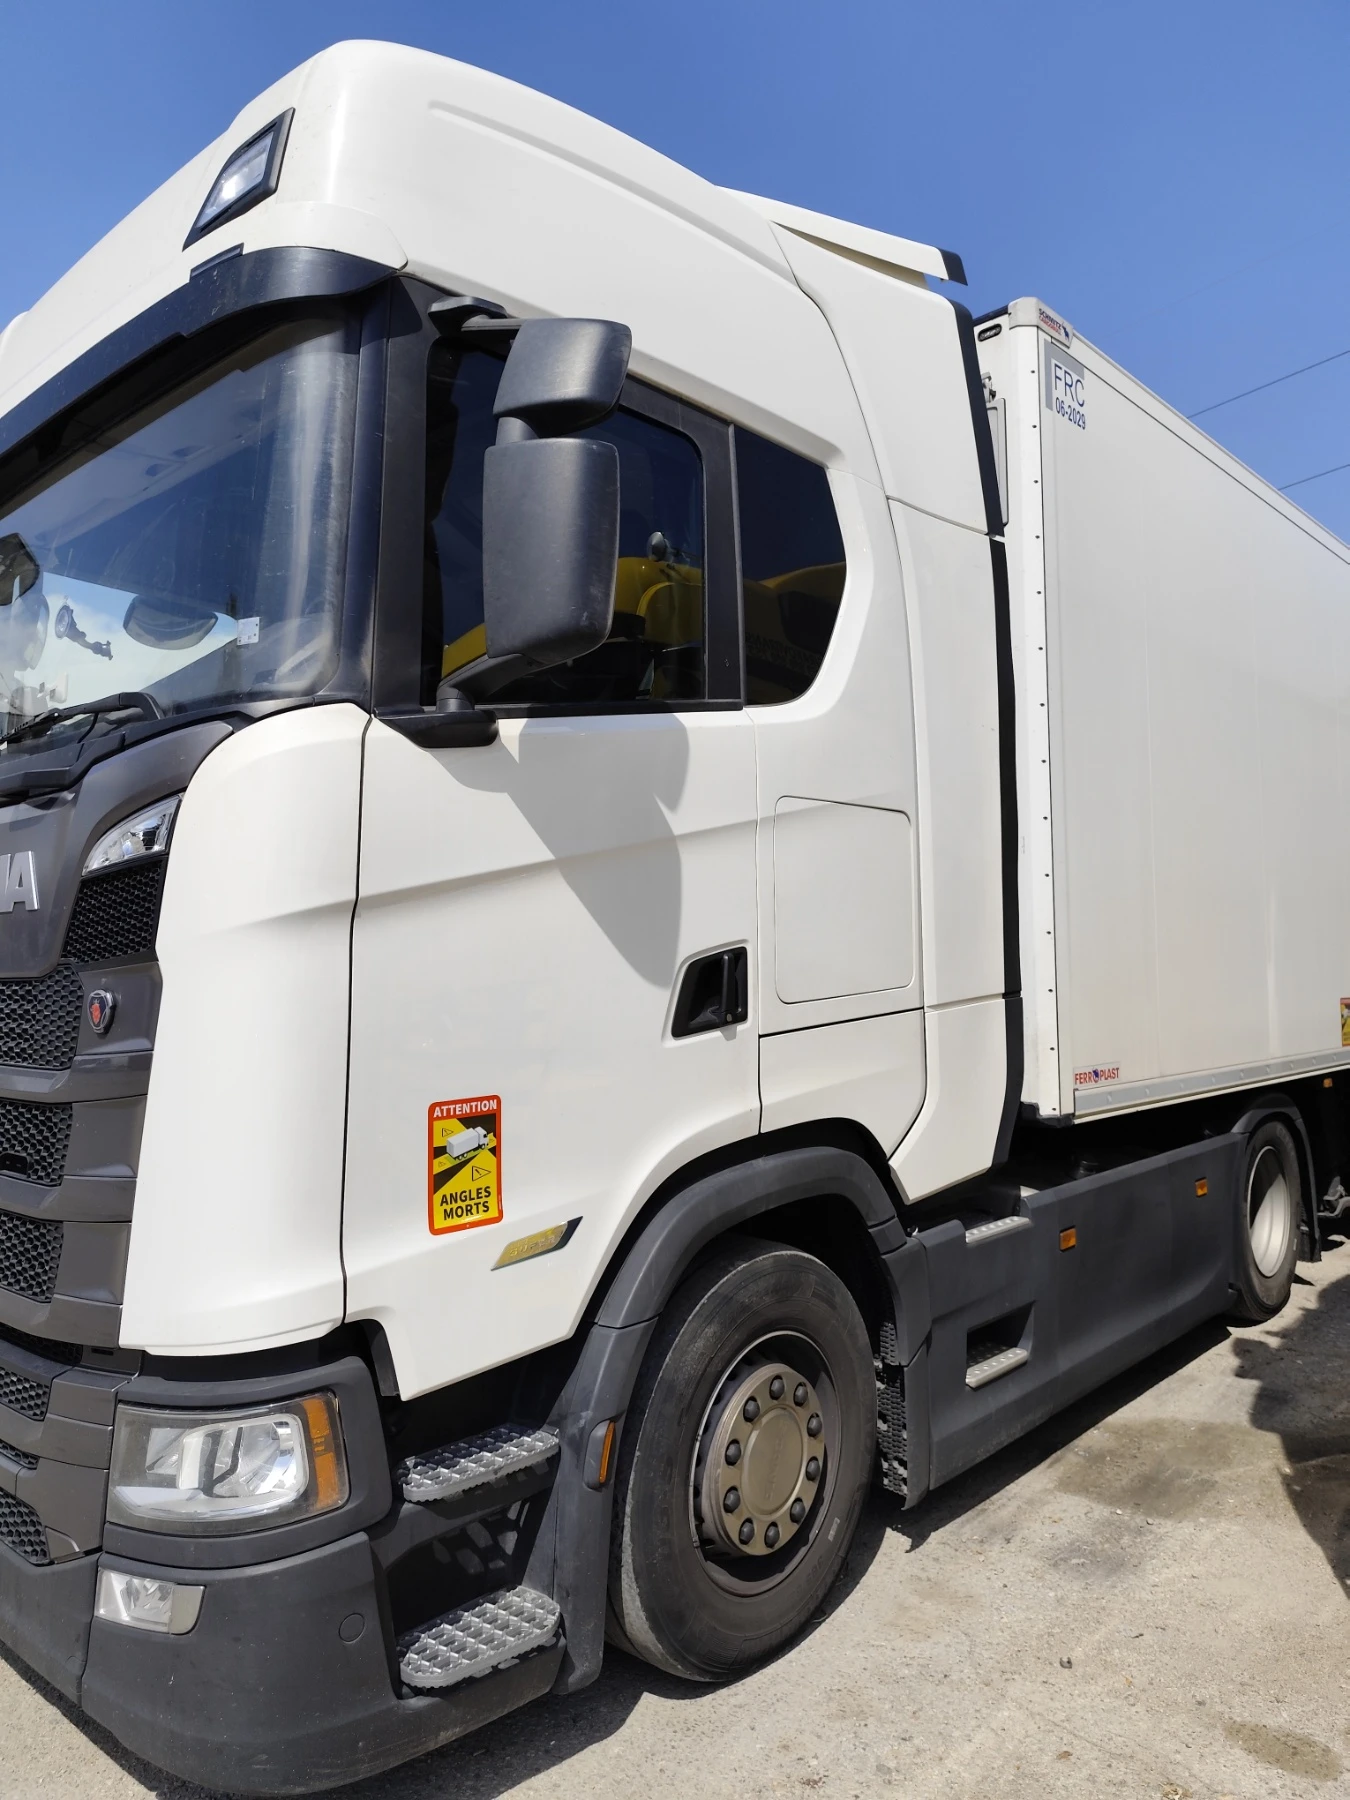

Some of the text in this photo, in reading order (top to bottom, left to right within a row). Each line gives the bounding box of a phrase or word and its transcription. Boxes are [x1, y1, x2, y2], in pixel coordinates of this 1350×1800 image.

[1053, 363, 1086, 408] FRC
[1055, 397, 1086, 430] 06-2029
[433, 1099, 498, 1118] ATTENTION
[440, 1186, 492, 1207] ANGLES
[443, 1201, 490, 1221] MORTS
